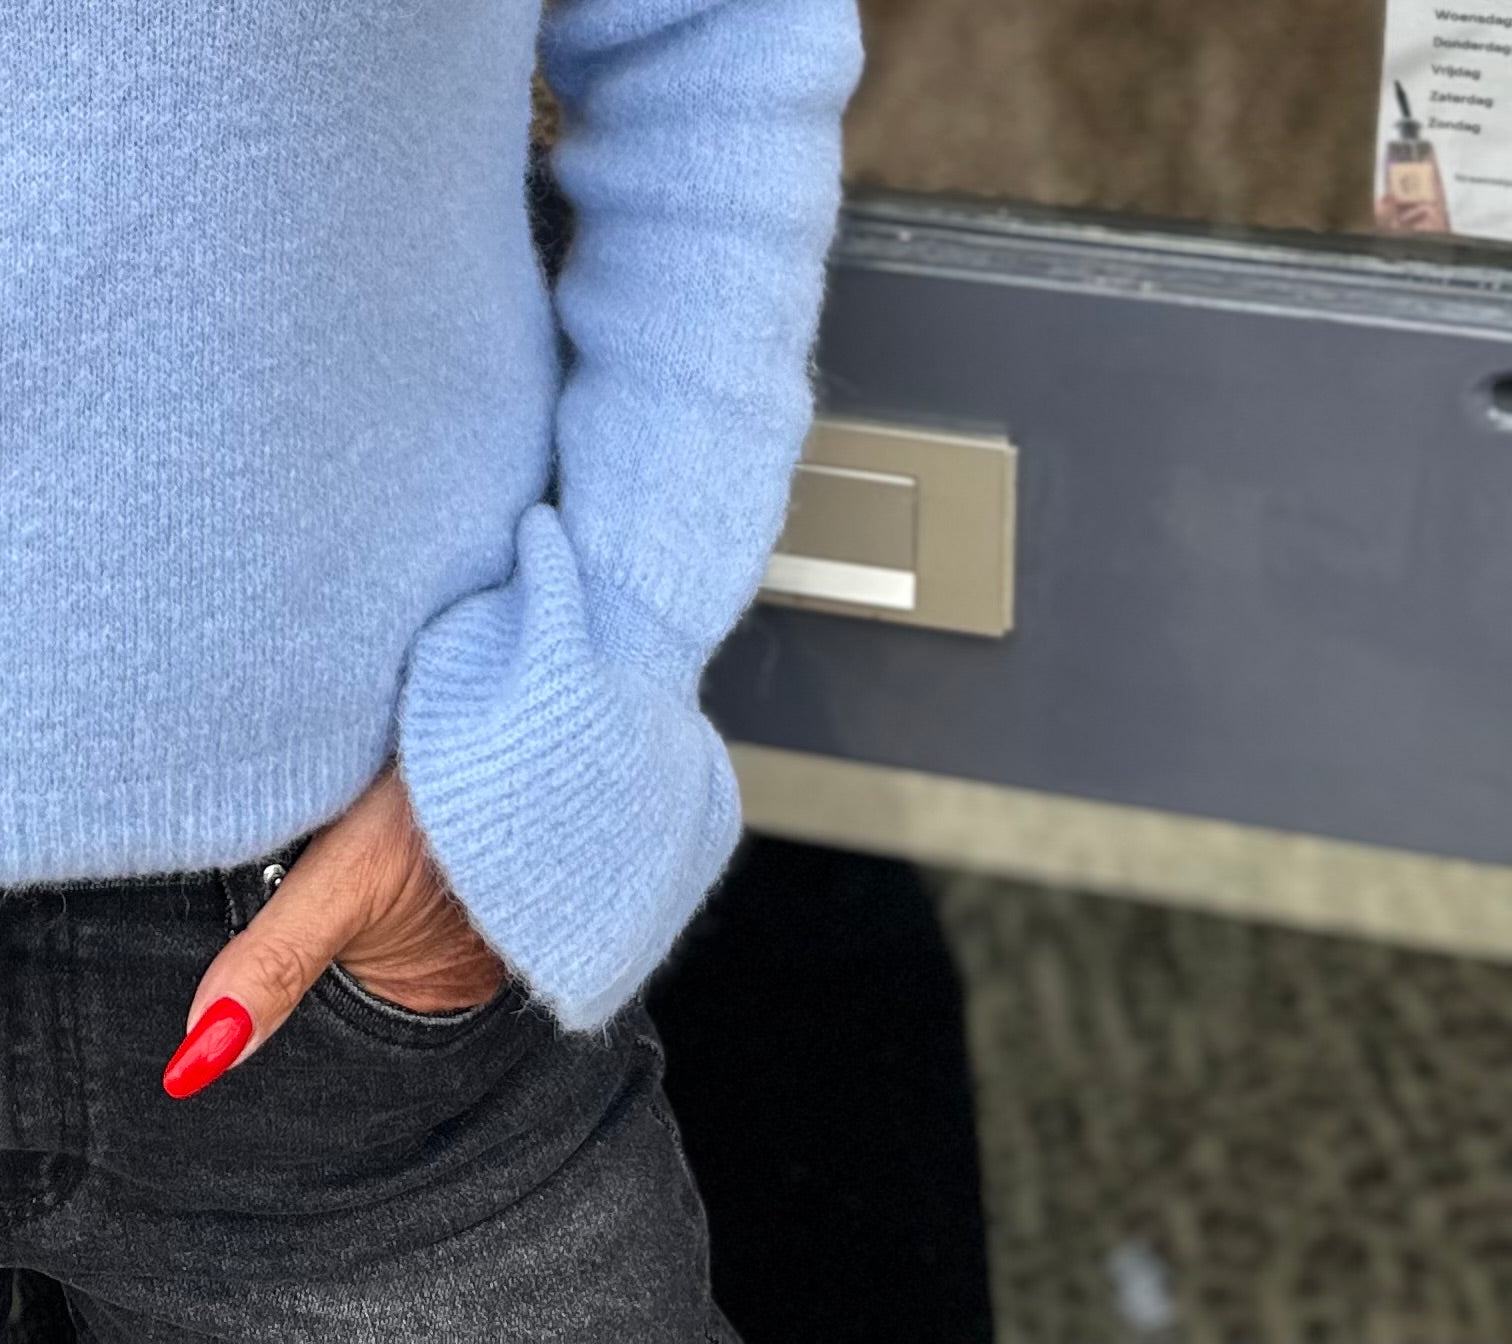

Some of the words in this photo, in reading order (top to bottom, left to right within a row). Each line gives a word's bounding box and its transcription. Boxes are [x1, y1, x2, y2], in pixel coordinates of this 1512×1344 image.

[1435, 10, 1512, 28] Woensdag
[1433, 36, 1512, 56] Donderdag
[1431, 64, 1481, 81] Vrijdag
[1429, 91, 1494, 109] Zaterdag
[1428, 117, 1481, 134] Zondag
